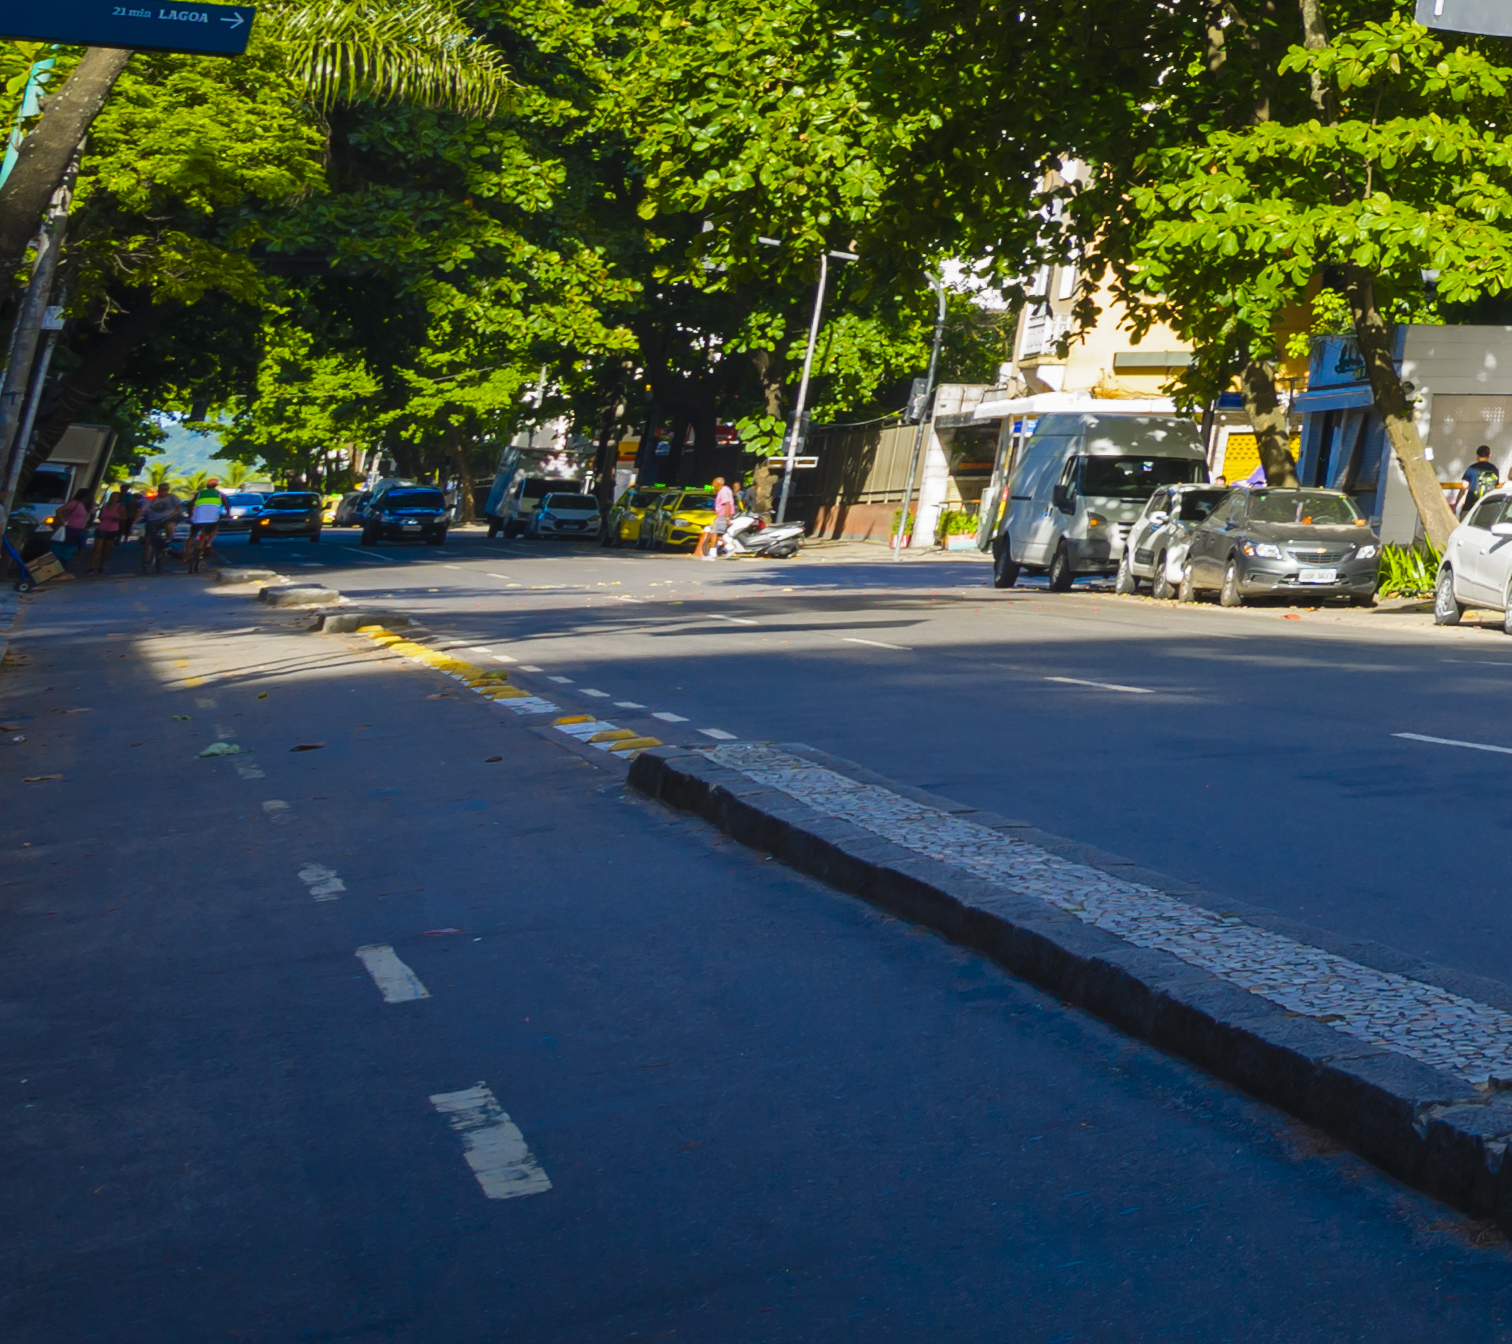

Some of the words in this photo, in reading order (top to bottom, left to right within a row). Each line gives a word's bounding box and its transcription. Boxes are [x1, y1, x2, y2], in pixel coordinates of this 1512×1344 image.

[112, 6, 127, 16] 21
[128, 8, 152, 18] min
[157, 9, 209, 23] LAGOA
